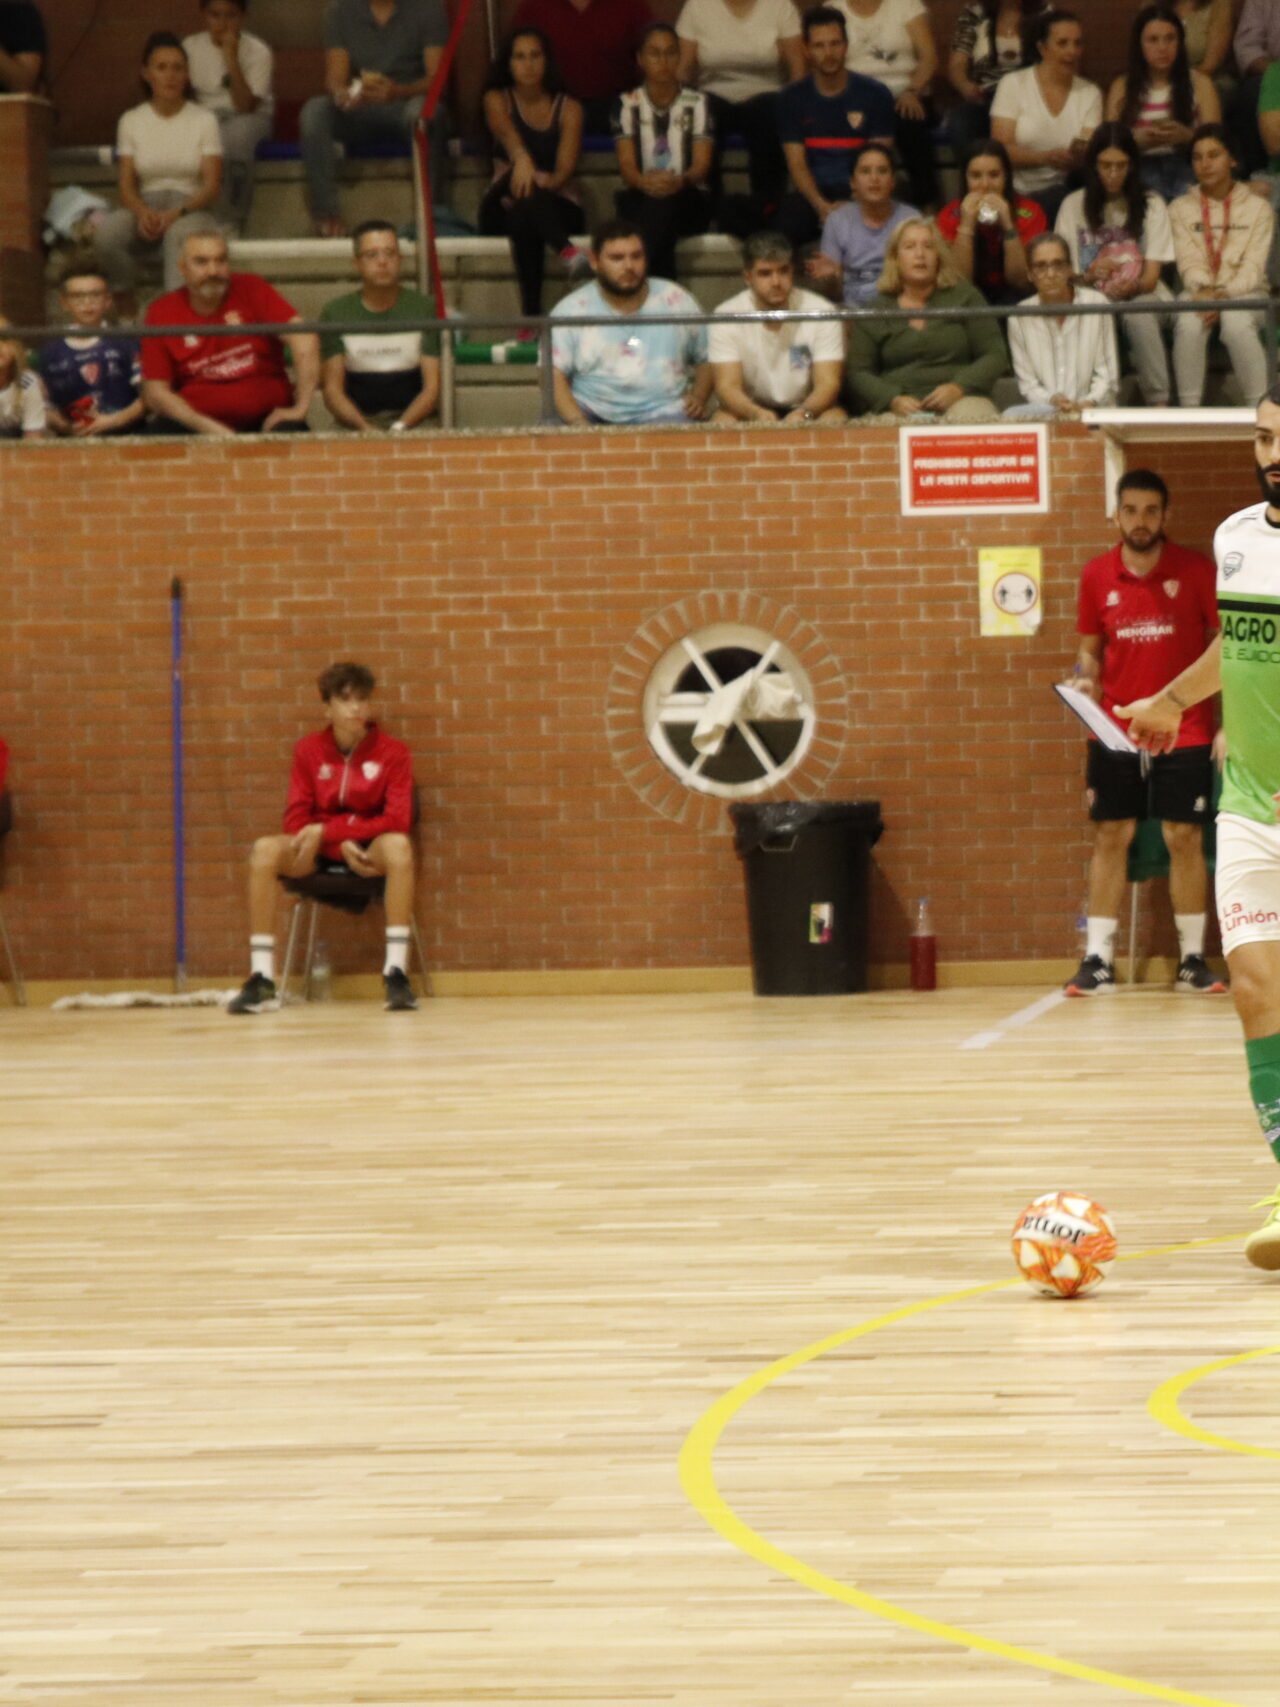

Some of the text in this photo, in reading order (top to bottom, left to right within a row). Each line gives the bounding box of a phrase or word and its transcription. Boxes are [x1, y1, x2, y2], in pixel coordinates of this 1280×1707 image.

[914, 455, 1034, 469] PROHIBIDO ESCUPIR EN
[920, 472, 1030, 486] LA PISTA DEPORTIVA
[1223, 902, 1242, 917] La
